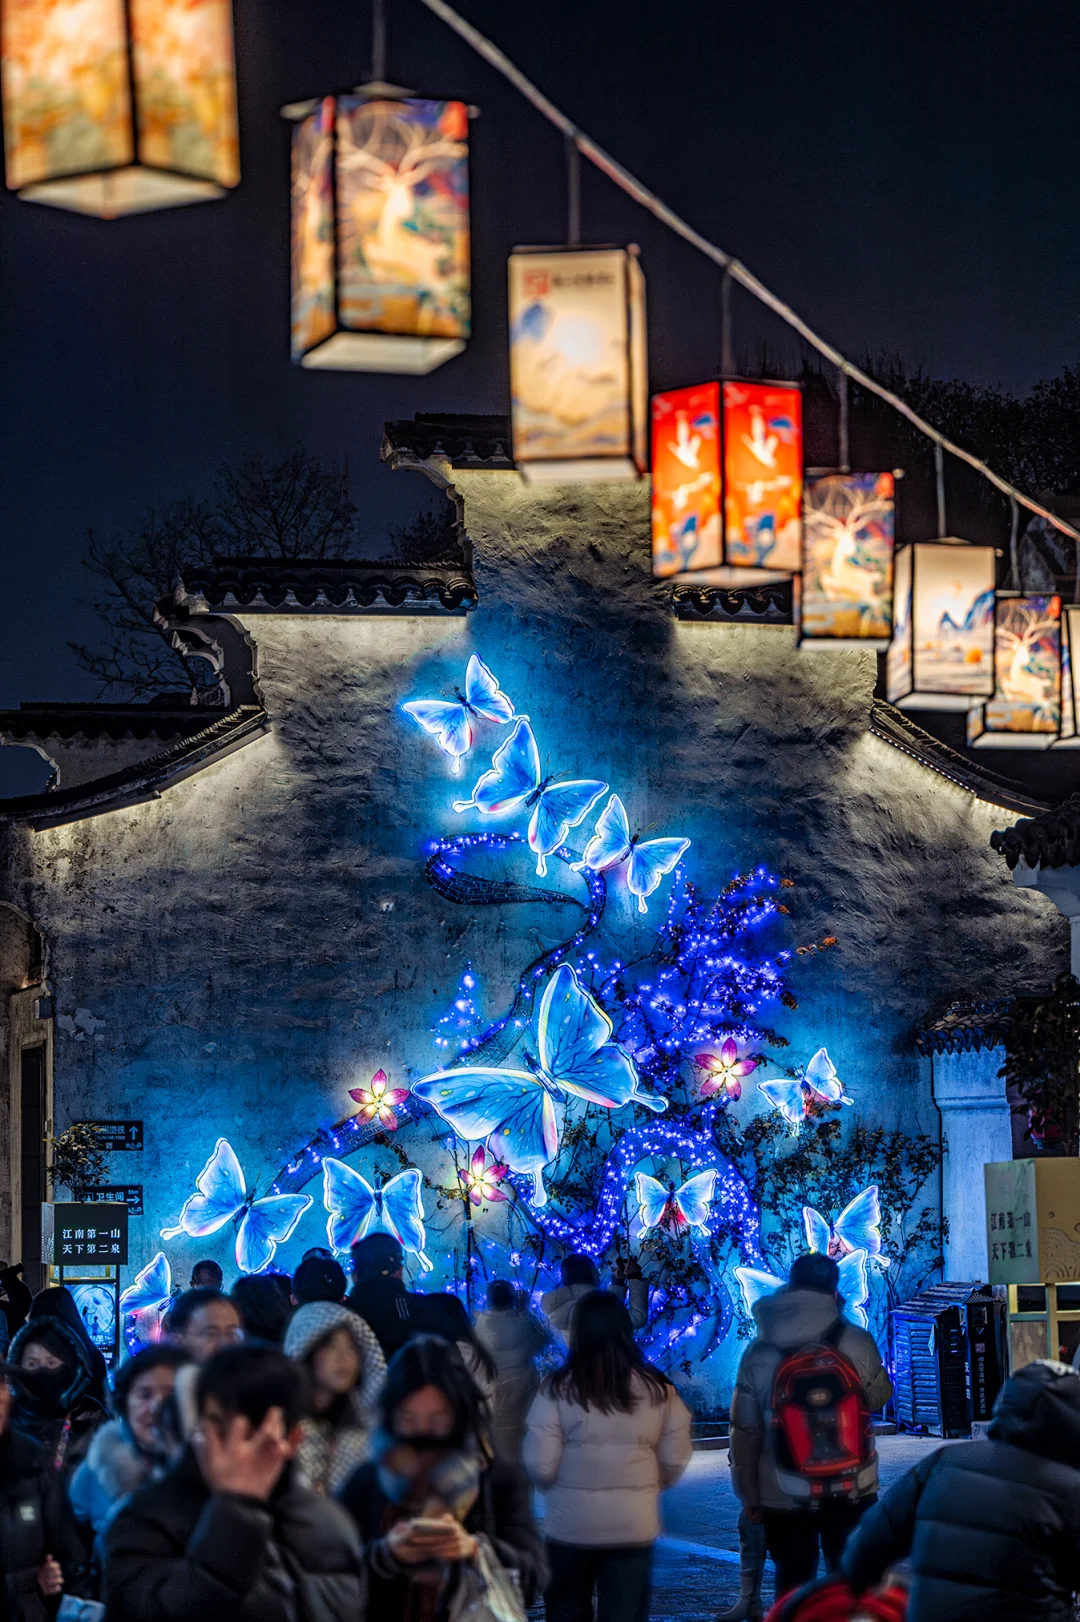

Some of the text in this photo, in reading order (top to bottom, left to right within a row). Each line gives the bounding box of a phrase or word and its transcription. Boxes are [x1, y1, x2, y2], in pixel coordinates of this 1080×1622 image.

[96, 1191, 125, 1202] 卫生间
[990, 1210, 1031, 1231] 江南第一山
[62, 1228, 121, 1240] 江南第一山
[62, 1243, 121, 1255] 天下第二泉
[991, 1239, 1033, 1261] 天下第二泉
